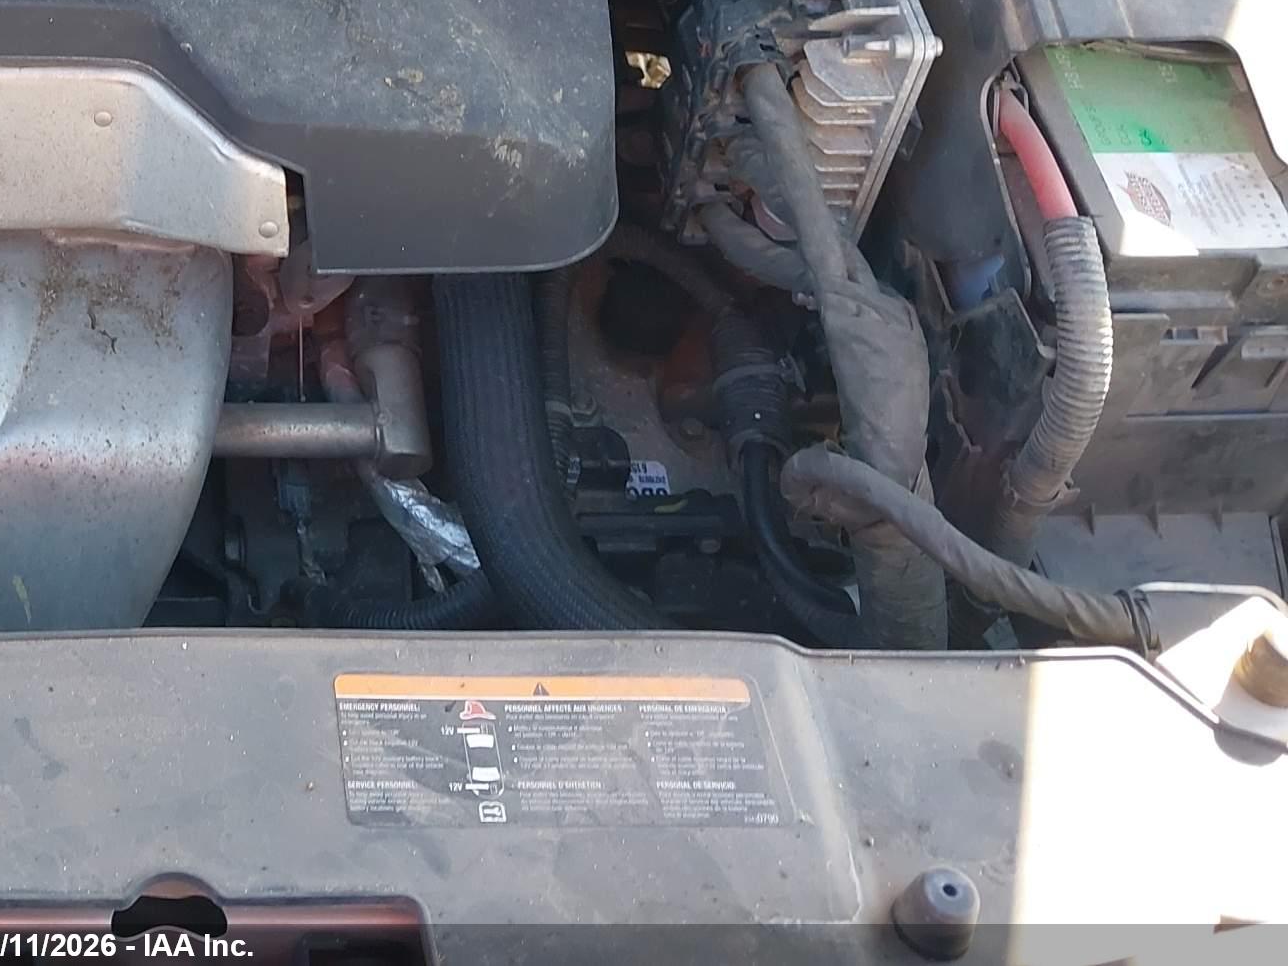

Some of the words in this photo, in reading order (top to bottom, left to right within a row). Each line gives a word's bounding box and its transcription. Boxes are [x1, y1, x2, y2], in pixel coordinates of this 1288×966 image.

[339, 702, 379, 711] EMERGENCY
[504, 704, 542, 713] PERSONNEL
[639, 705, 674, 713] PERSONAL
[674, 705, 684, 713] DE
[441, 725, 454, 735] 12V
[347, 780, 374, 789] SERVICE
[449, 782, 462, 792] 12V
[517, 781, 556, 790] PERSONNEL
[656, 781, 692, 789] PERSONAL
[692, 781, 703, 789] DE
